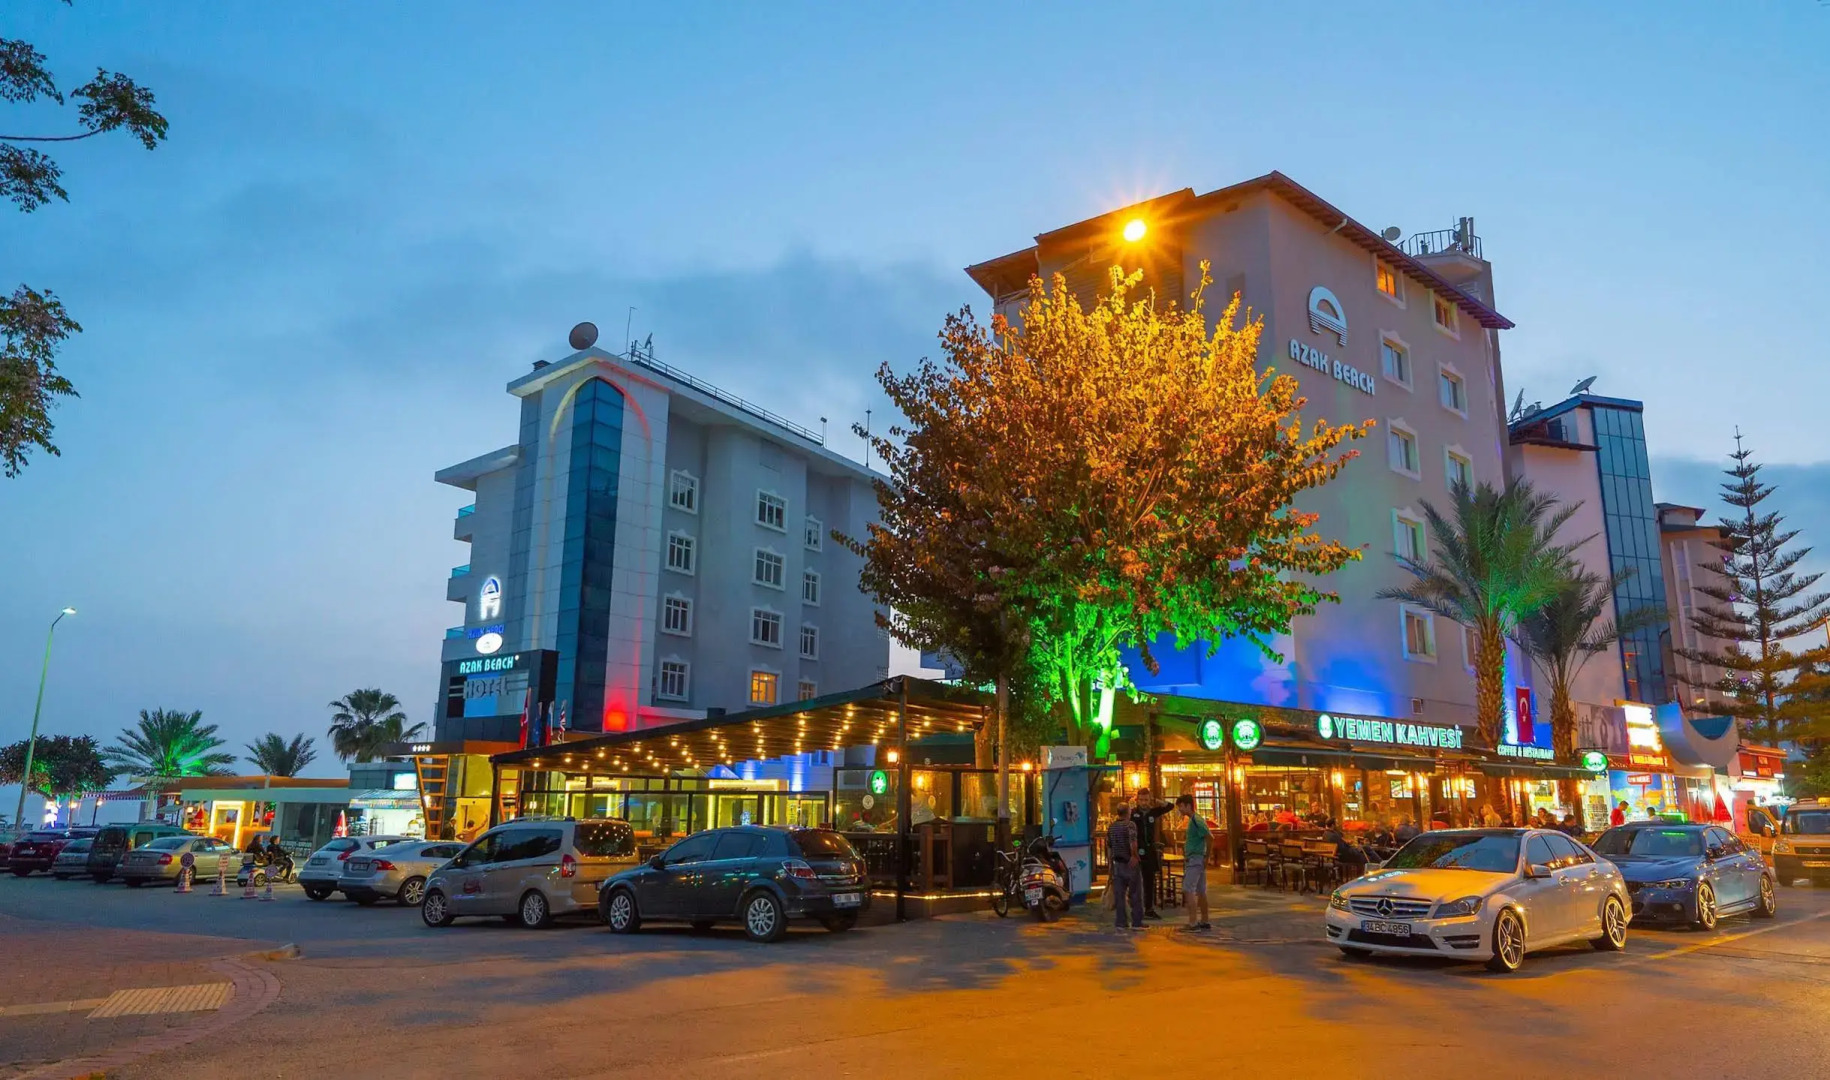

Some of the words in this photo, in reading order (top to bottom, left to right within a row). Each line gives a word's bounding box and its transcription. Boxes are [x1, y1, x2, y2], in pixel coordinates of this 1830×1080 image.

[1289, 338, 1329, 374] AZAK
[1332, 359, 1376, 395] BEACH
[459, 659, 483, 674] AZAK
[484, 655, 514, 672] BEACH
[463, 676, 510, 700] HOTEL
[1333, 716, 1395, 744] YEMEN
[1396, 723, 1463, 749] KAHVESİ
[1497, 744, 1518, 757] COFFEE
[1523, 746, 1555, 760] RESTAURANT
